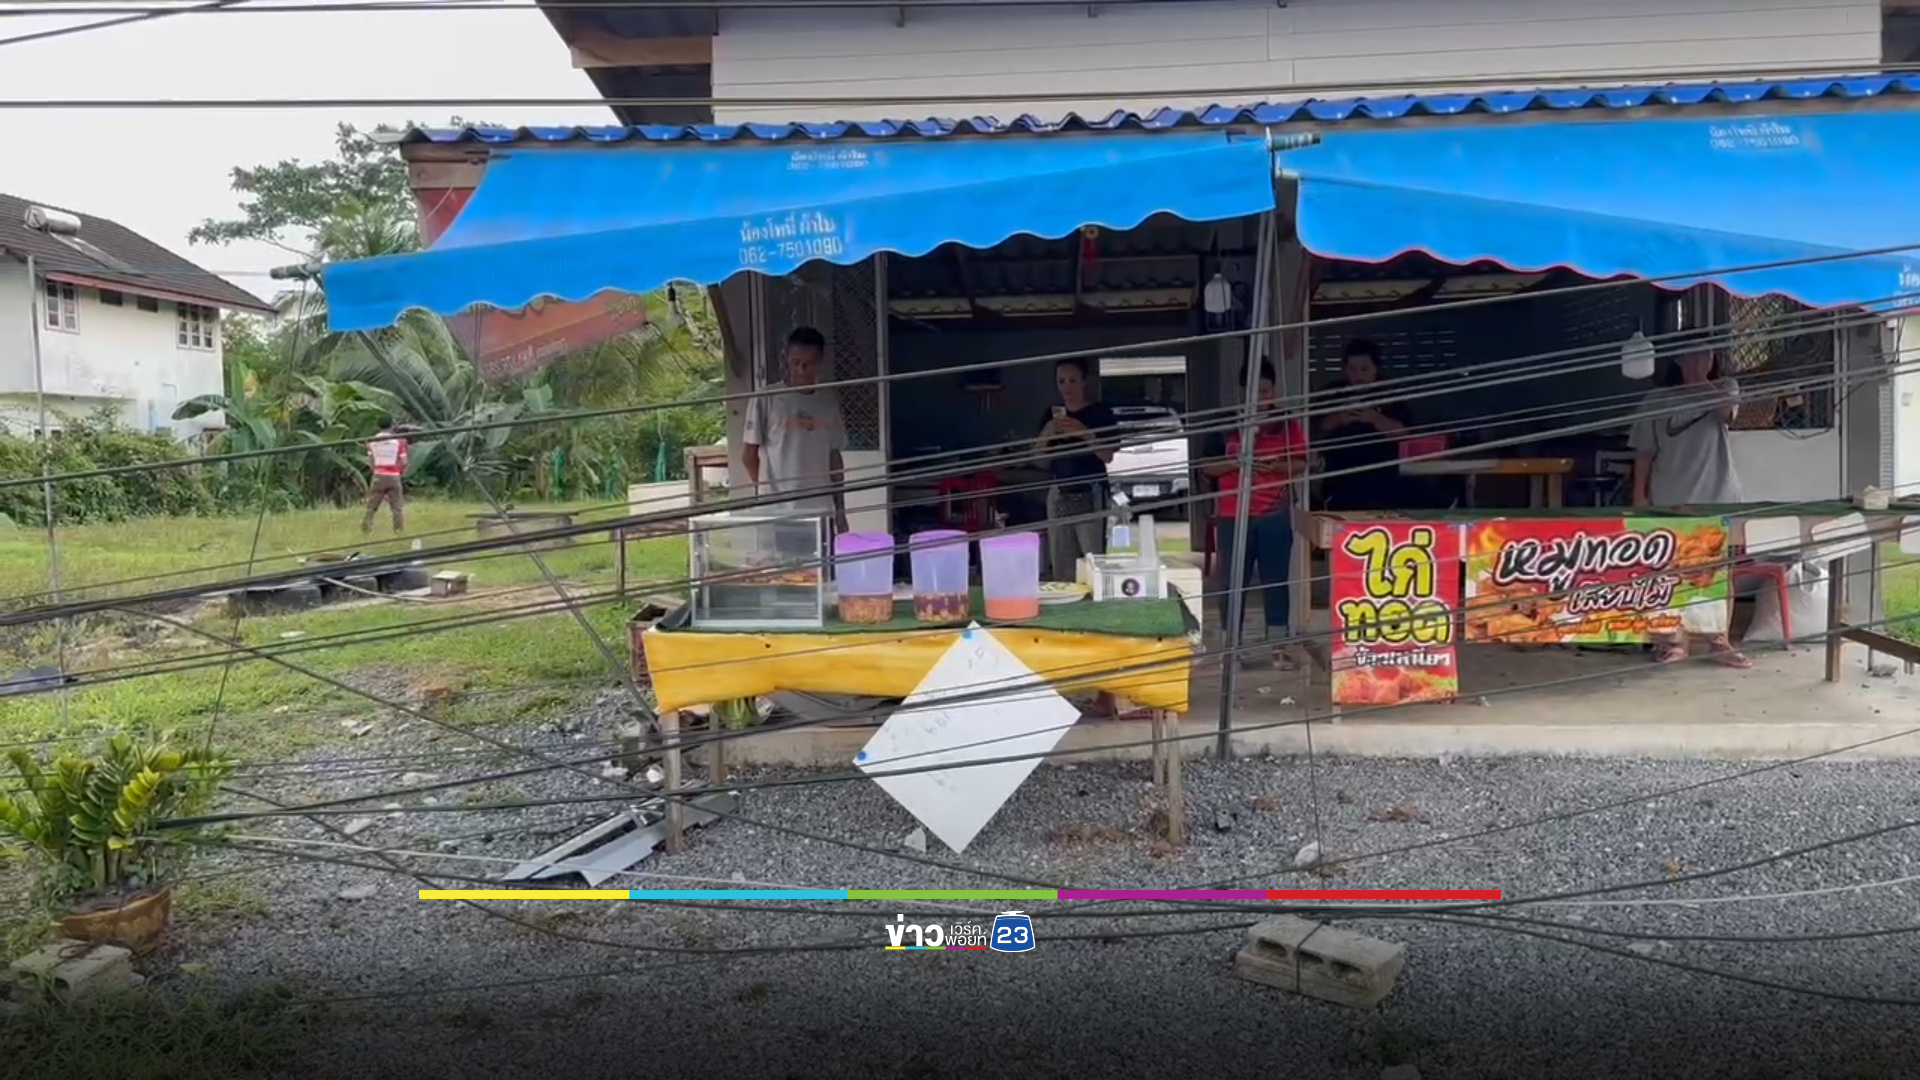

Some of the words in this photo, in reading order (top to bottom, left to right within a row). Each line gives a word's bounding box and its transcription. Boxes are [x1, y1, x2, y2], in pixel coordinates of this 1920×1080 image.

[738, 236, 843, 264] 062-7501090
[1345, 528, 1435, 598] ไก่
[1496, 530, 1674, 600] หมูทอด
[1340, 599, 1451, 645] ทอด
